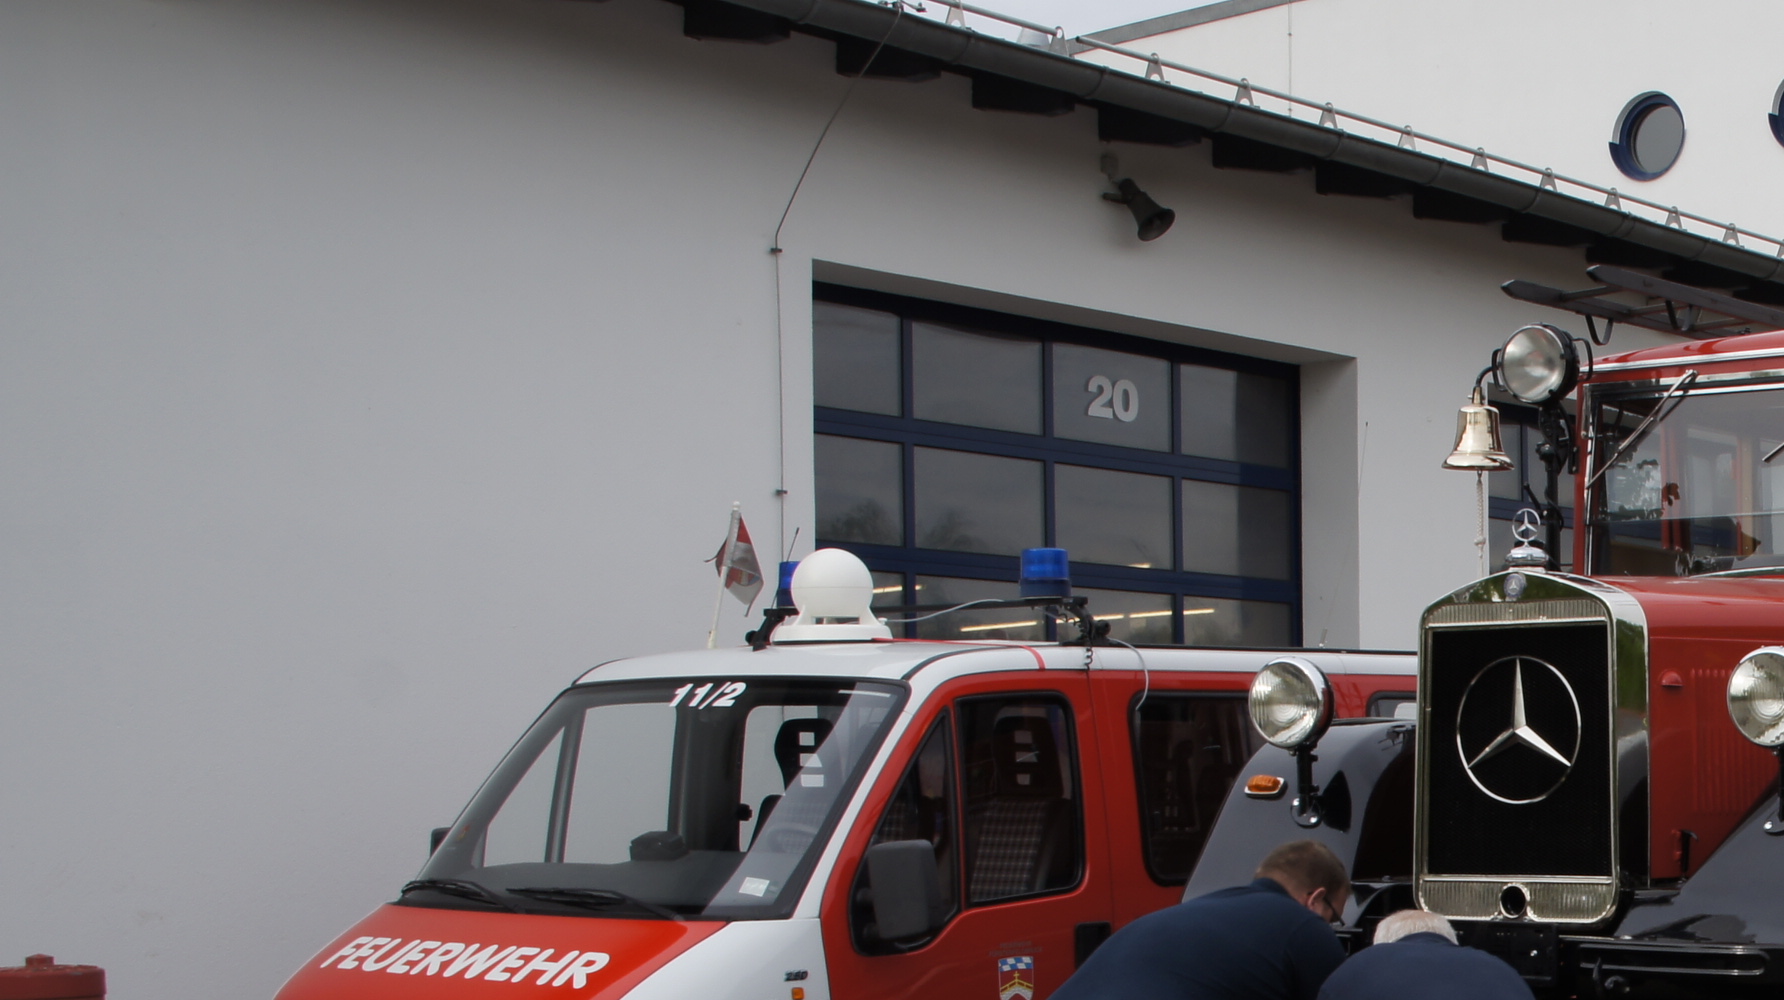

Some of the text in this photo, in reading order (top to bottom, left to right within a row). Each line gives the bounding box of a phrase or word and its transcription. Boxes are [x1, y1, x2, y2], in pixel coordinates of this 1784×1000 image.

[1087, 375, 1139, 422] 20
[669, 681, 747, 710] 11/2
[319, 936, 610, 989] FEUERWEHR
